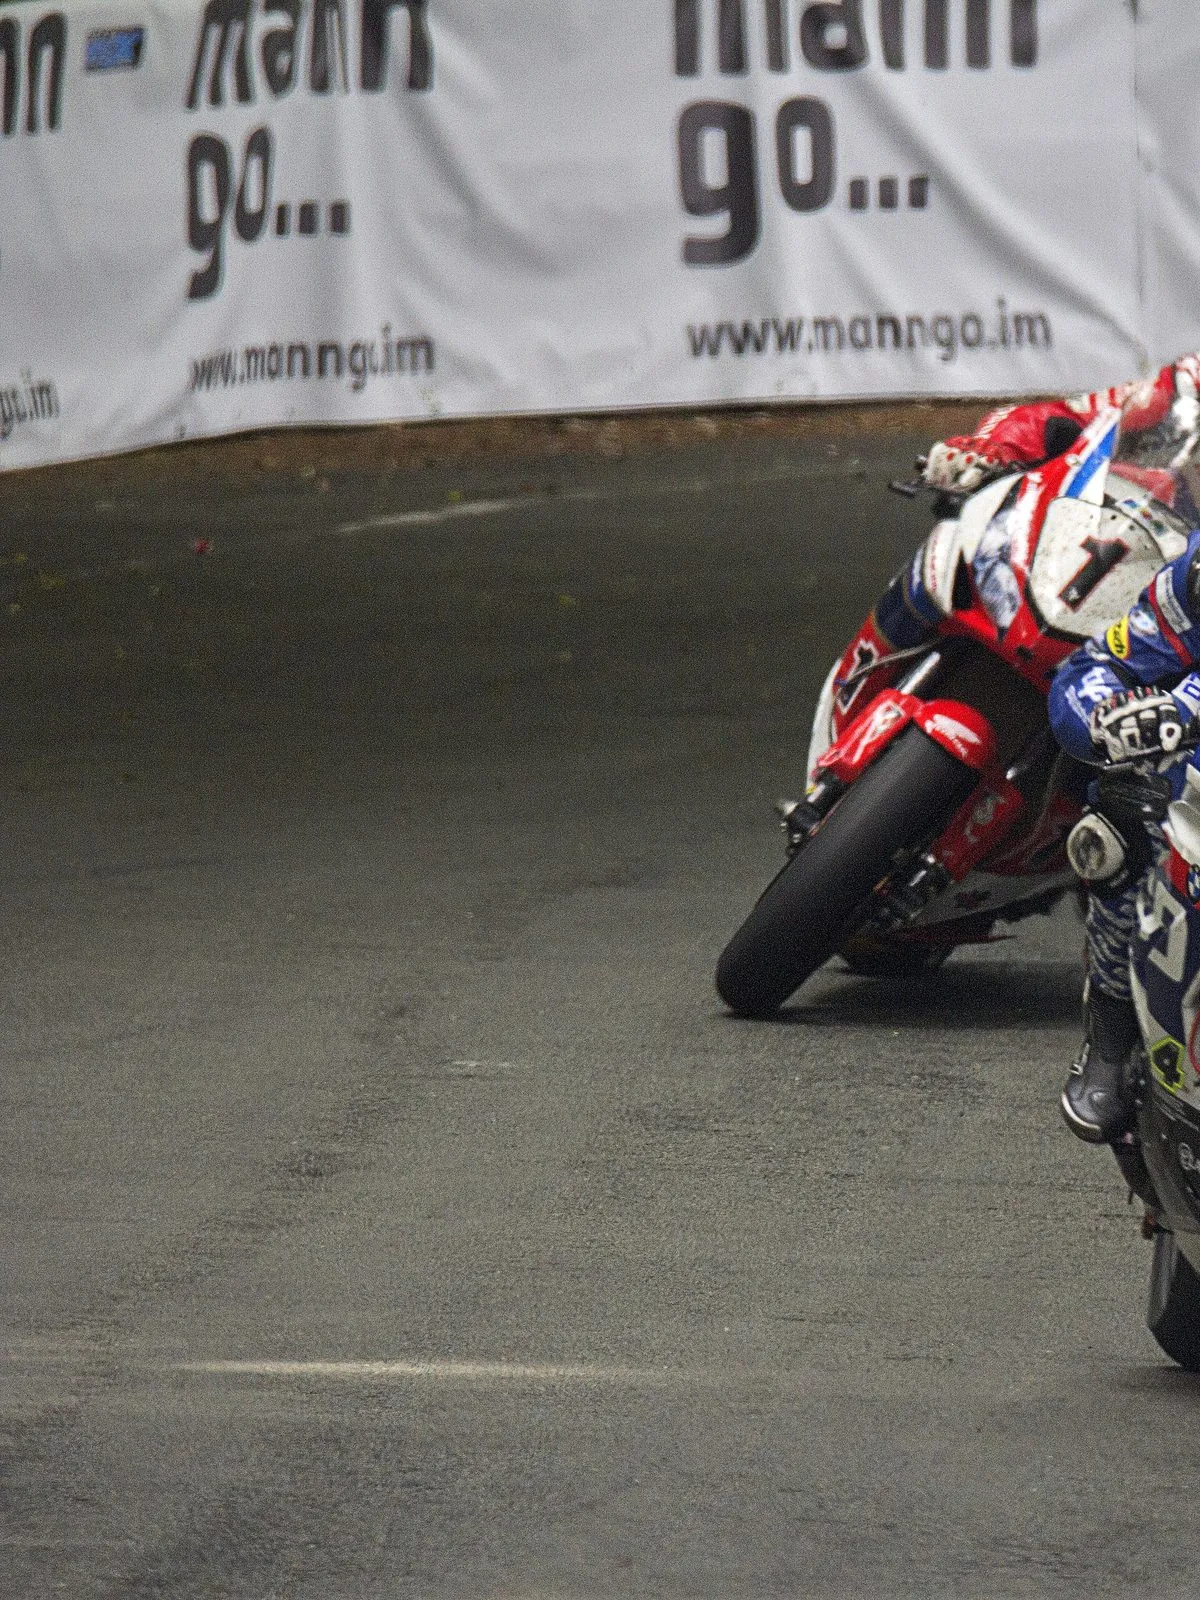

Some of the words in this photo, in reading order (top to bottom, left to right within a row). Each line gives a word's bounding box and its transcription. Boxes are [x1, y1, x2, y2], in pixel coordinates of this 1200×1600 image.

[186, 0, 435, 108] mann
[186, 125, 351, 299] go...
[677, 95, 929, 268] go...
[687, 300, 1053, 361] www.manngo.im
[1057, 535, 1130, 613] 1
